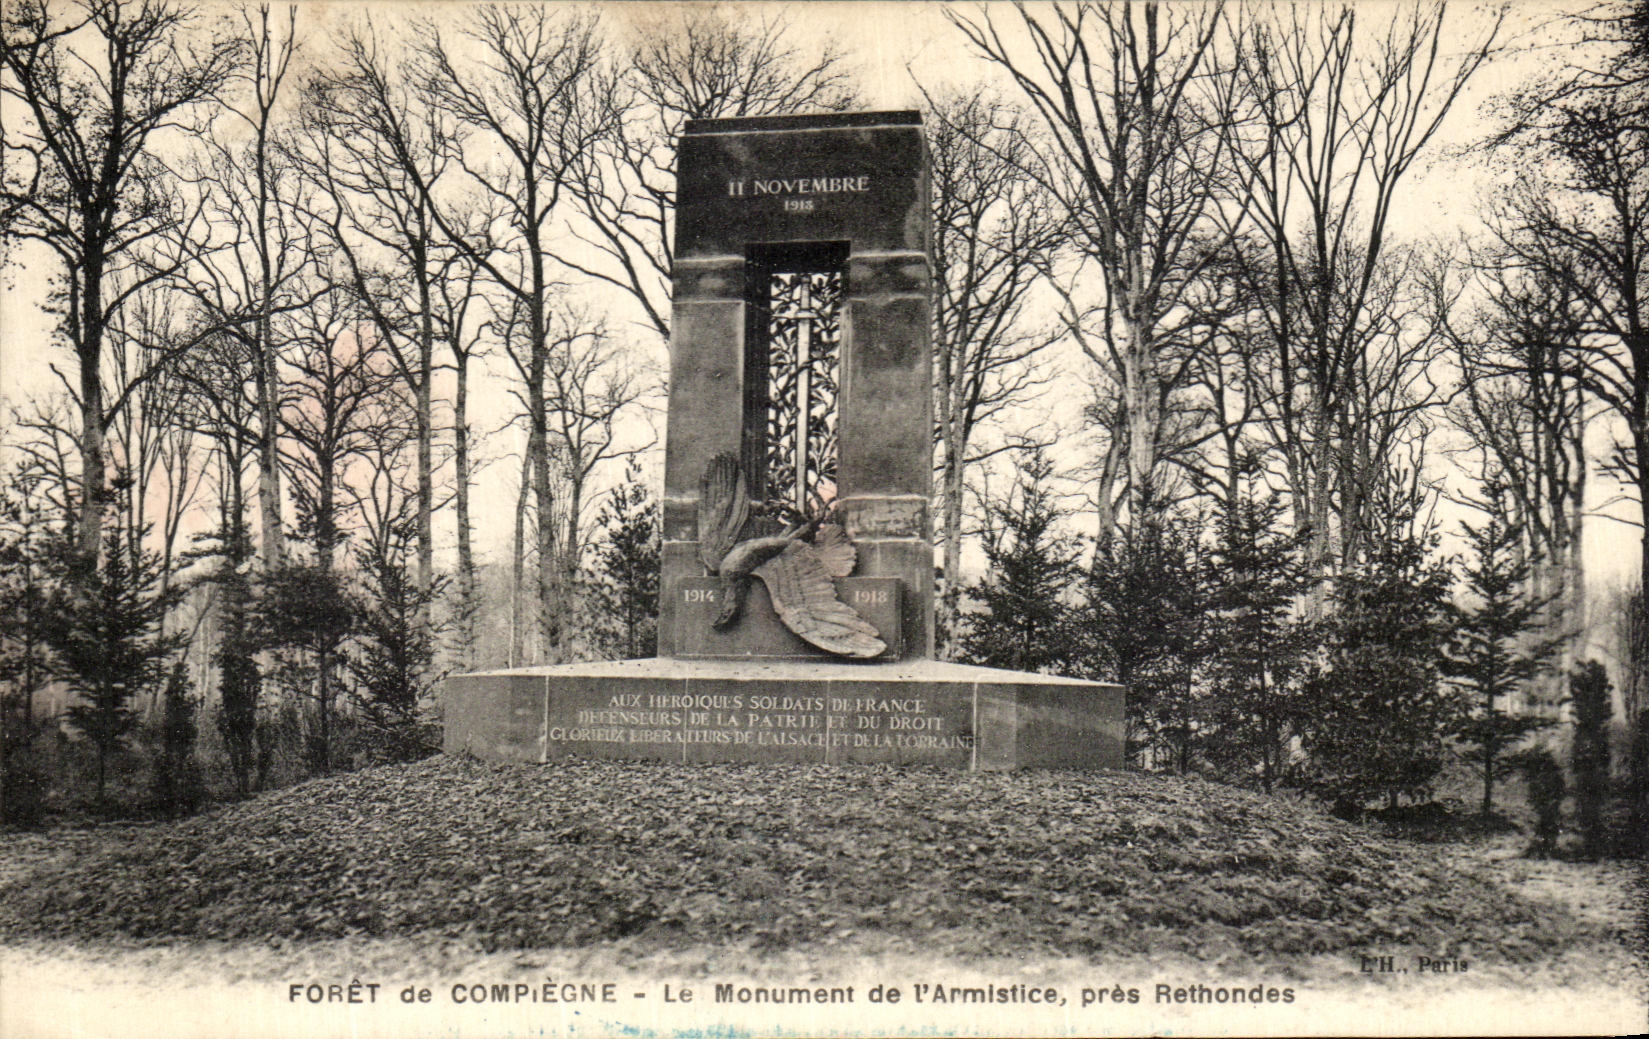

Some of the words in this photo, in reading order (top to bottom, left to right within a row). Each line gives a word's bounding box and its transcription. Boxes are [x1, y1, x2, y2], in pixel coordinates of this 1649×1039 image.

[754, 176, 870, 195] NOVEMBRE
[784, 200, 814, 212] 1918
[684, 589, 714, 603] 1914
[855, 590, 887, 603] 1918
[608, 694, 641, 707] AUX
[750, 696, 824, 711] SOLDATS
[832, 698, 852, 712] DE
[856, 698, 926, 713] FRANCE
[690, 712, 710, 726] DE
[717, 713, 739, 727] LA
[748, 713, 820, 728] PATRIE
[828, 715, 848, 729] ET
[859, 715, 880, 729] DU
[889, 716, 945, 731] DROIT
[550, 727, 625, 741] GLORIEUX
[734, 731, 754, 744] DE
[758, 731, 827, 746] L'ALSACE
[832, 733, 852, 747] ET
[854, 733, 872, 747] DE
[874, 734, 892, 747] LA
[896, 734, 975, 749] LORRAINE
